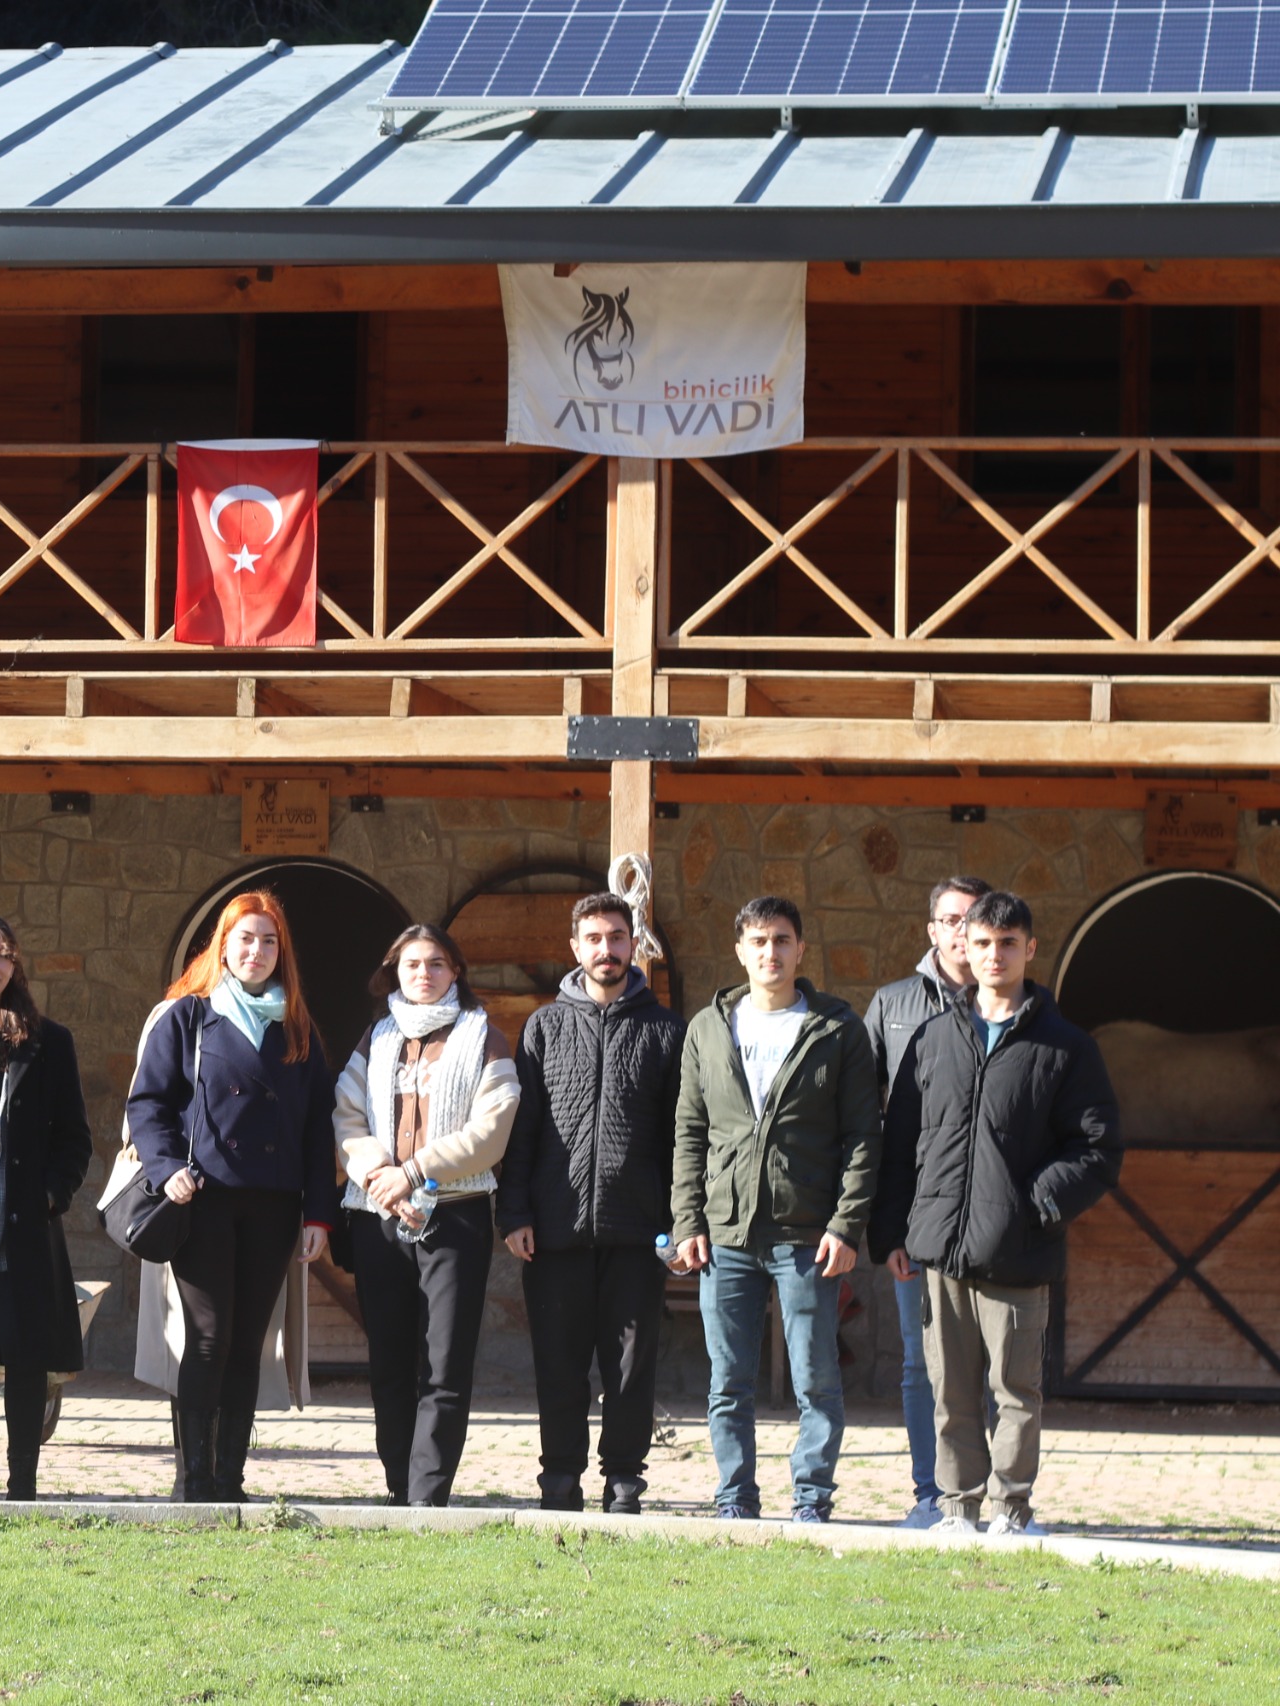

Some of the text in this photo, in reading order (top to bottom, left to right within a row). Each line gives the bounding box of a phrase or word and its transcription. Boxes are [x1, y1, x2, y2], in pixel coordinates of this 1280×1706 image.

[664, 374, 775, 400] binicilik
[553, 398, 775, 436] ATLI VADİ
